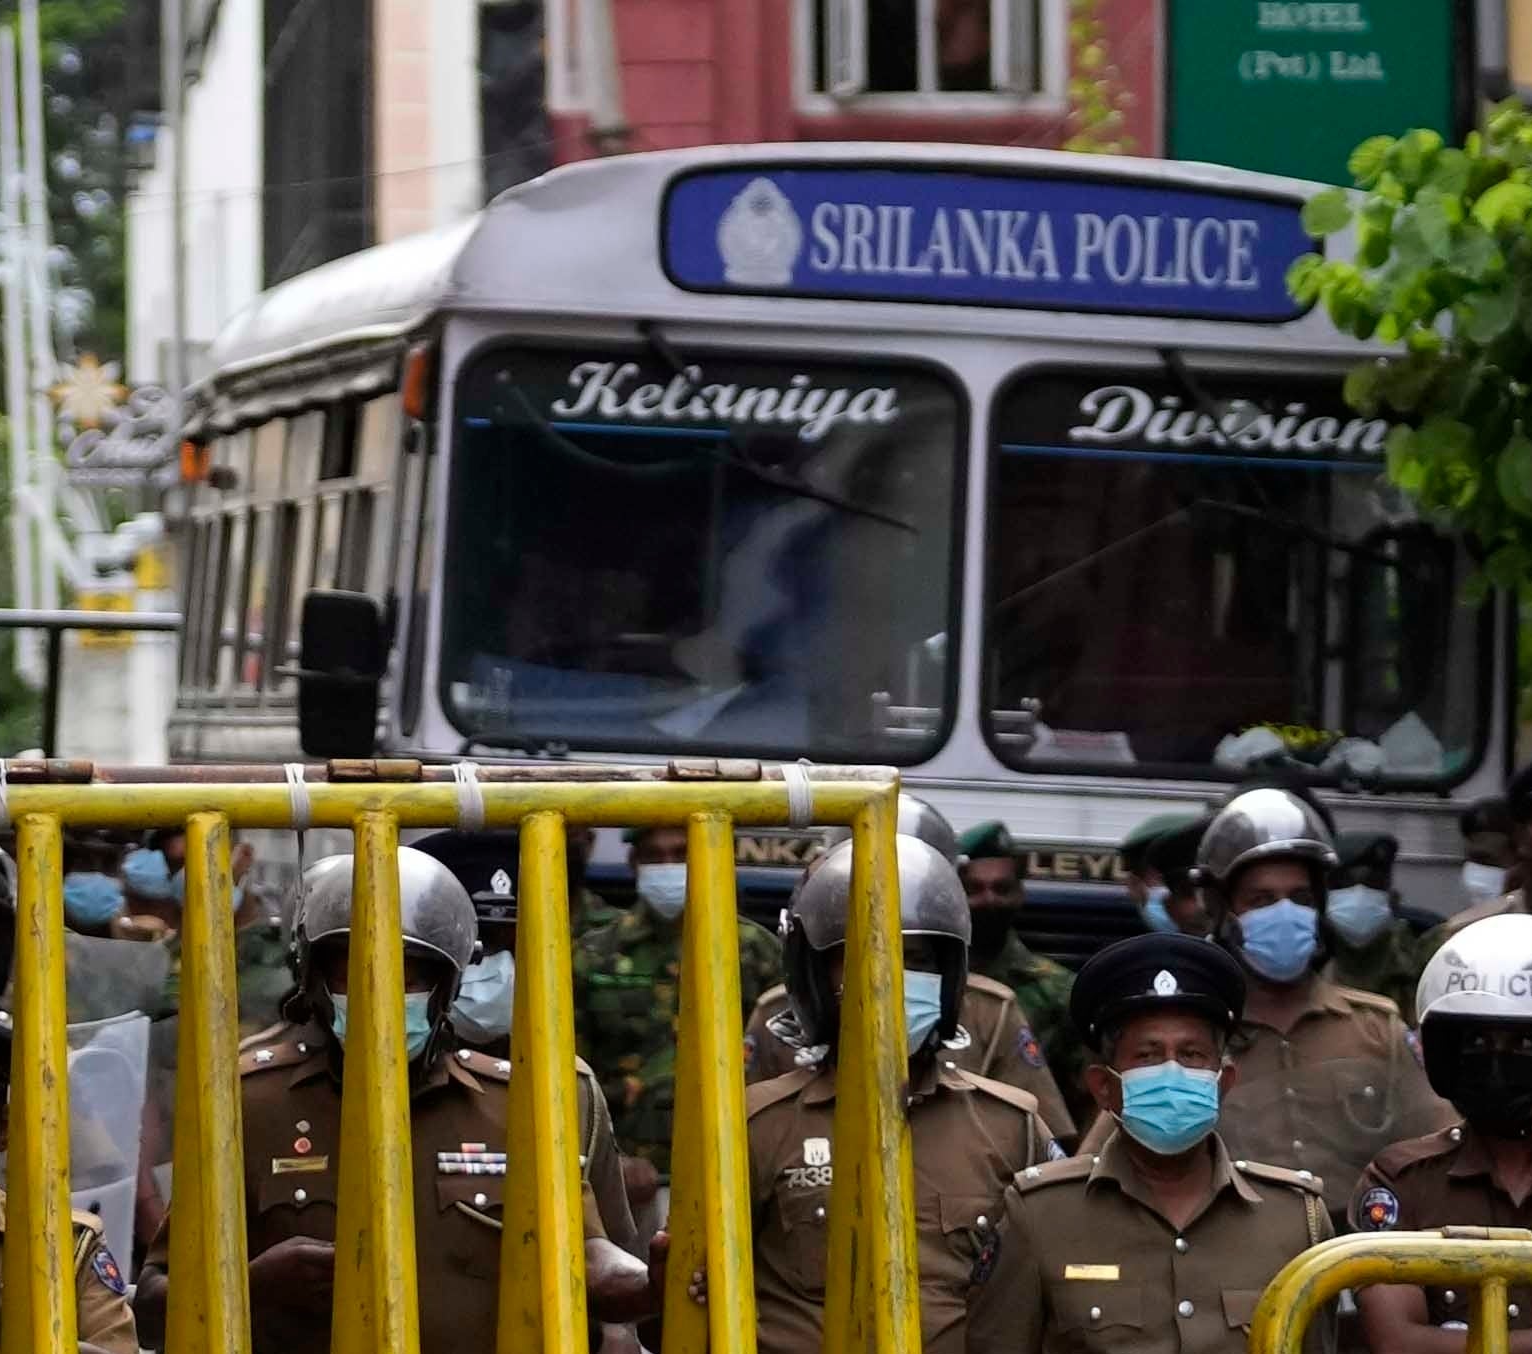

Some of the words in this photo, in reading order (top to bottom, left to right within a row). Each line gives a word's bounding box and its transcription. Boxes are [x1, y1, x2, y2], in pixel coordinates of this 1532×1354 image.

[1257, 2, 1367, 30] HOTEL
[1239, 51, 1319, 79] (Pvt)
[810, 202, 1060, 282] SRILANKA
[1073, 212, 1260, 290] POLICE
[550, 361, 901, 442] Kelaniya
[1067, 385, 1391, 453] Division
